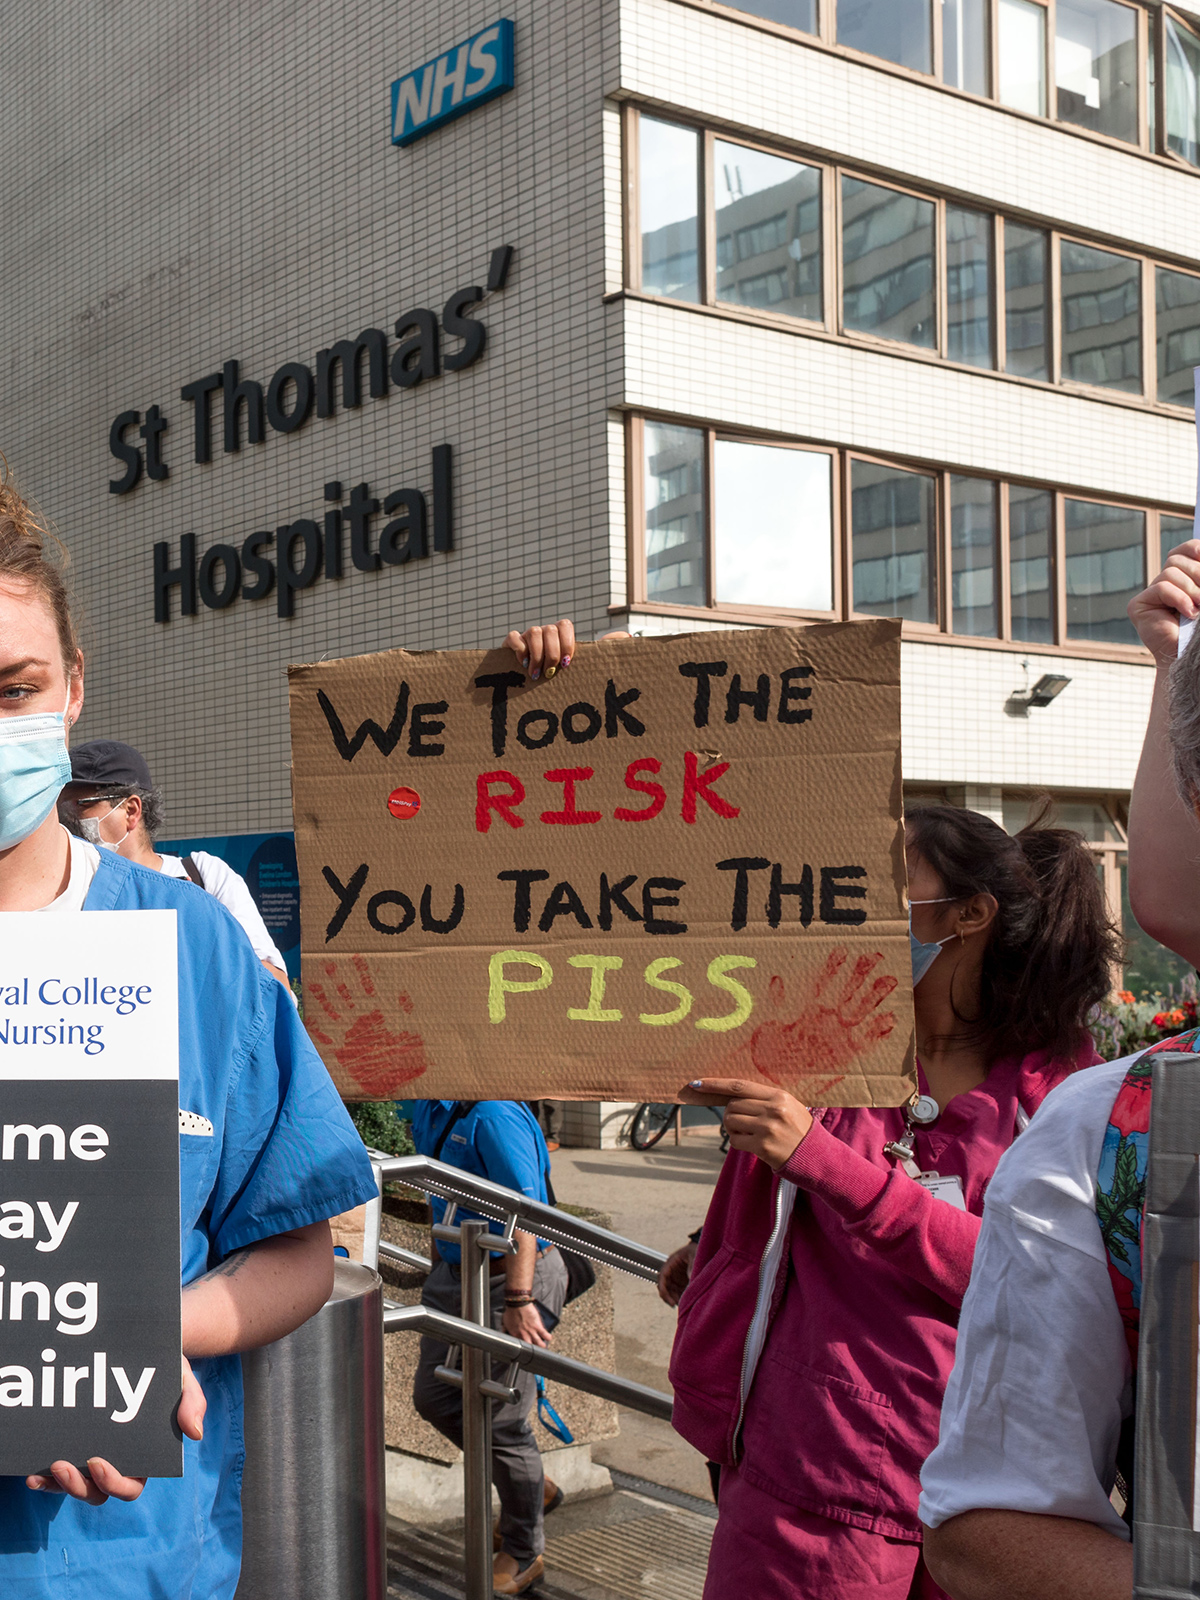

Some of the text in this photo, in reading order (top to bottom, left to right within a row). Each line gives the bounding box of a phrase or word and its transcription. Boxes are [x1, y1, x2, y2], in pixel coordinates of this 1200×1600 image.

[392, 25, 504, 138] NHS
[108, 404, 169, 496] St
[153, 443, 453, 624] Hospital
[316, 679, 450, 763] WE
[678, 660, 815, 729] THE
[474, 750, 742, 834] RISK
[321, 856, 868, 944] YOU TAKE THE
[37, 976, 152, 1015] College
[487, 949, 758, 1033] PISS
